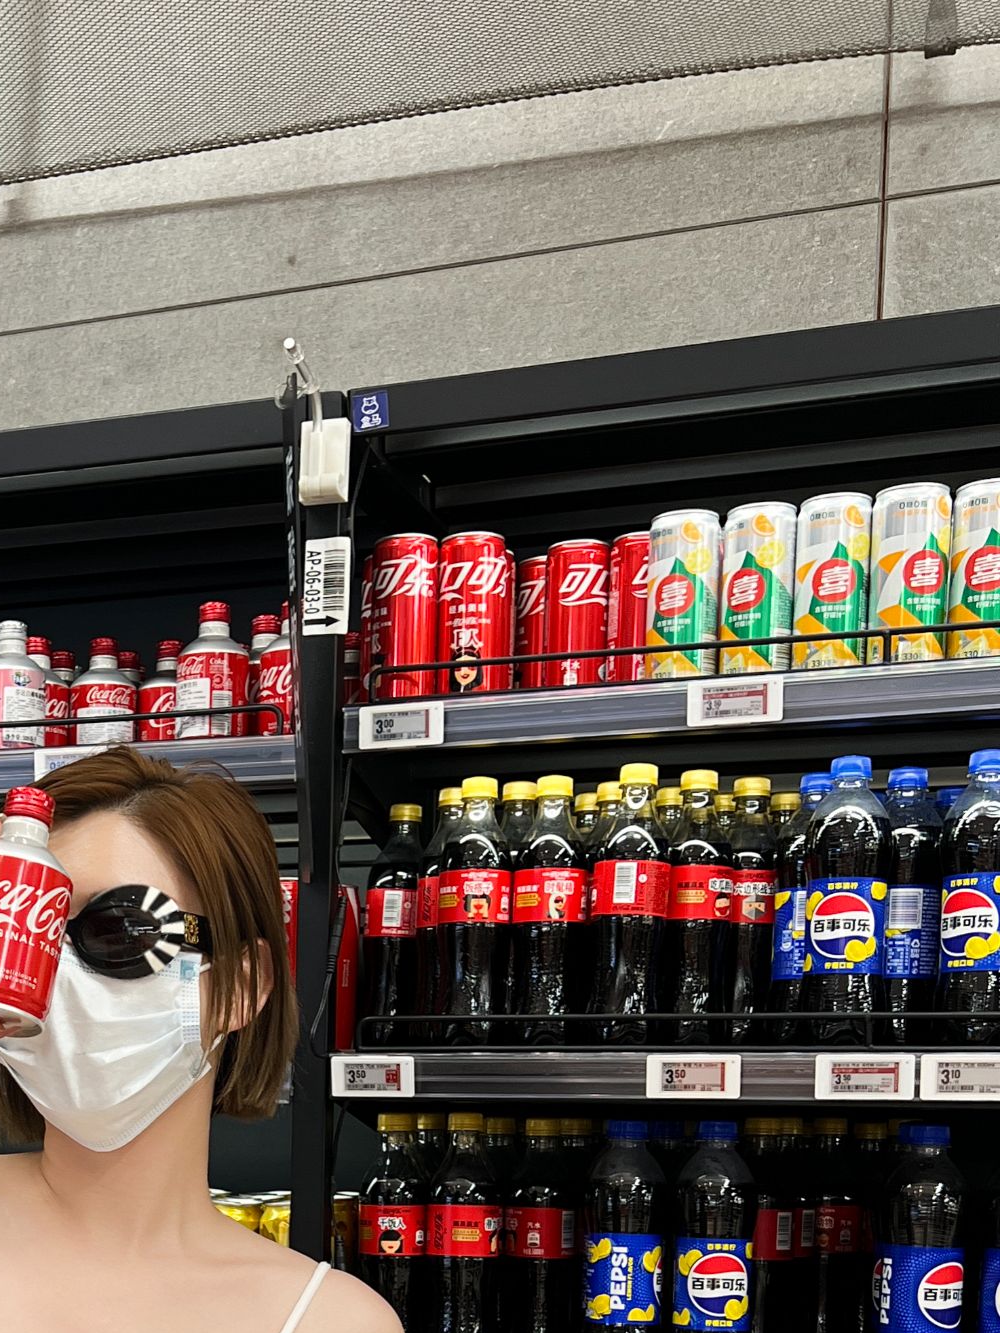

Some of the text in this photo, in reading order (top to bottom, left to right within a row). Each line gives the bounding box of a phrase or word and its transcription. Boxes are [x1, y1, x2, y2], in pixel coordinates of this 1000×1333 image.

[360, 414, 382, 430] 盒马
[304, 549, 321, 615] AP-06-03-0
[812, 914, 873, 934] 百事可乐
[941, 910, 995, 932] 百事可乐
[609, 1245, 629, 1312] PEPSI
[690, 1276, 747, 1294] 百事可乐
[879, 1256, 894, 1326] PEPSI
